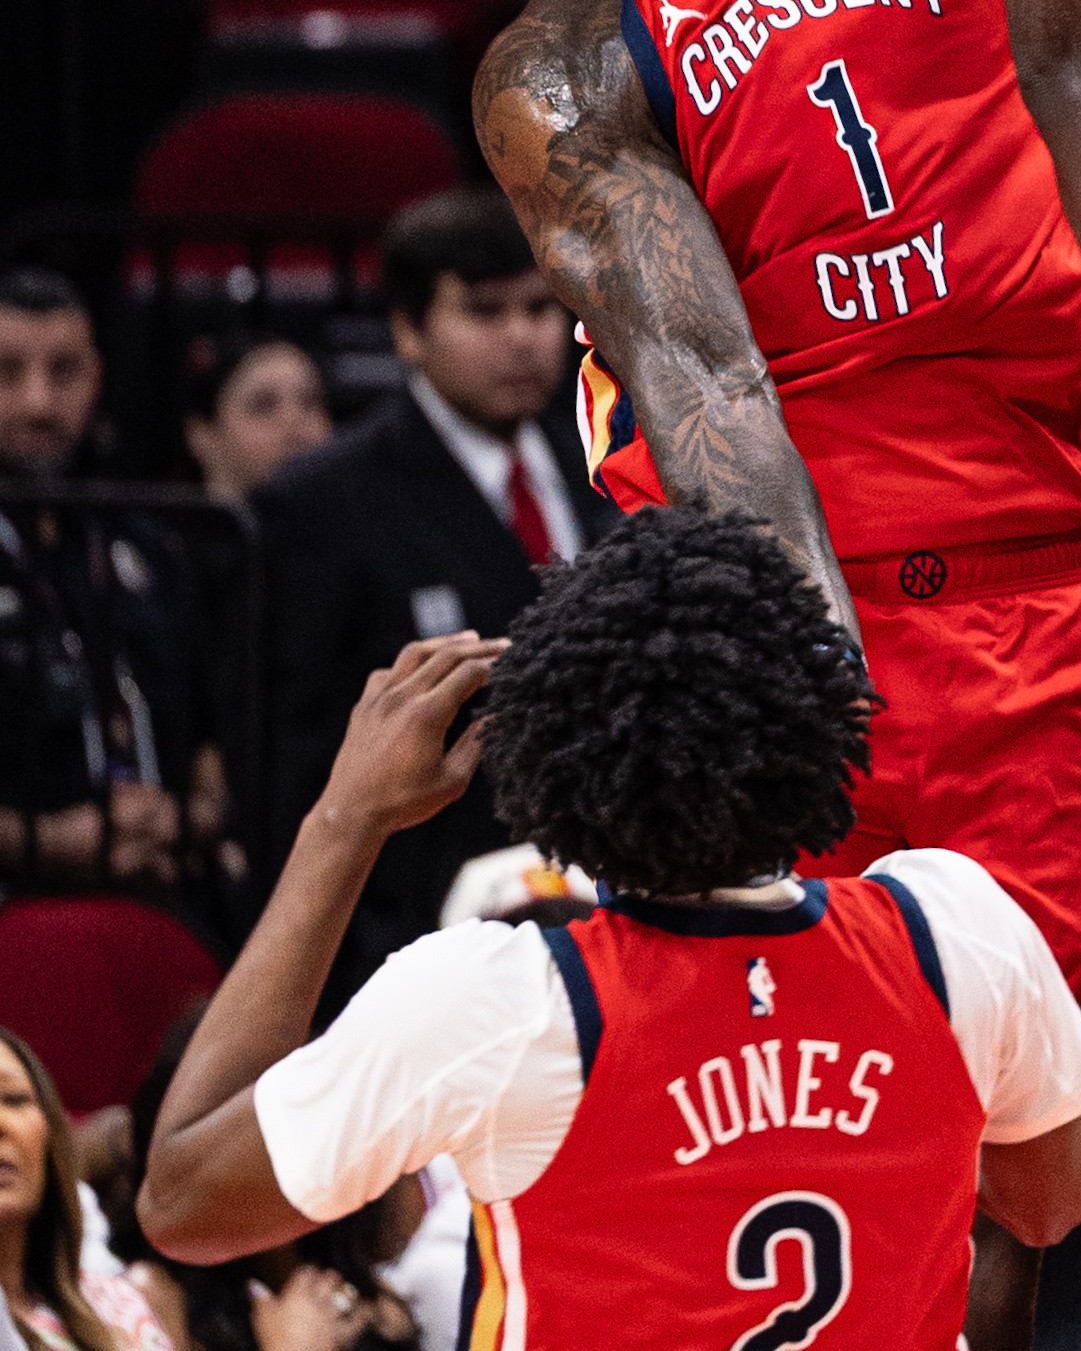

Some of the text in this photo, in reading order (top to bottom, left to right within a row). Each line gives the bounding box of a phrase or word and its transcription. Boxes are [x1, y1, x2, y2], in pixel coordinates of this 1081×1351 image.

[806, 58, 895, 220] 1
[815, 220, 949, 322] CITY
[666, 1039, 894, 1165] JONES
[726, 1190, 853, 1351] 2
